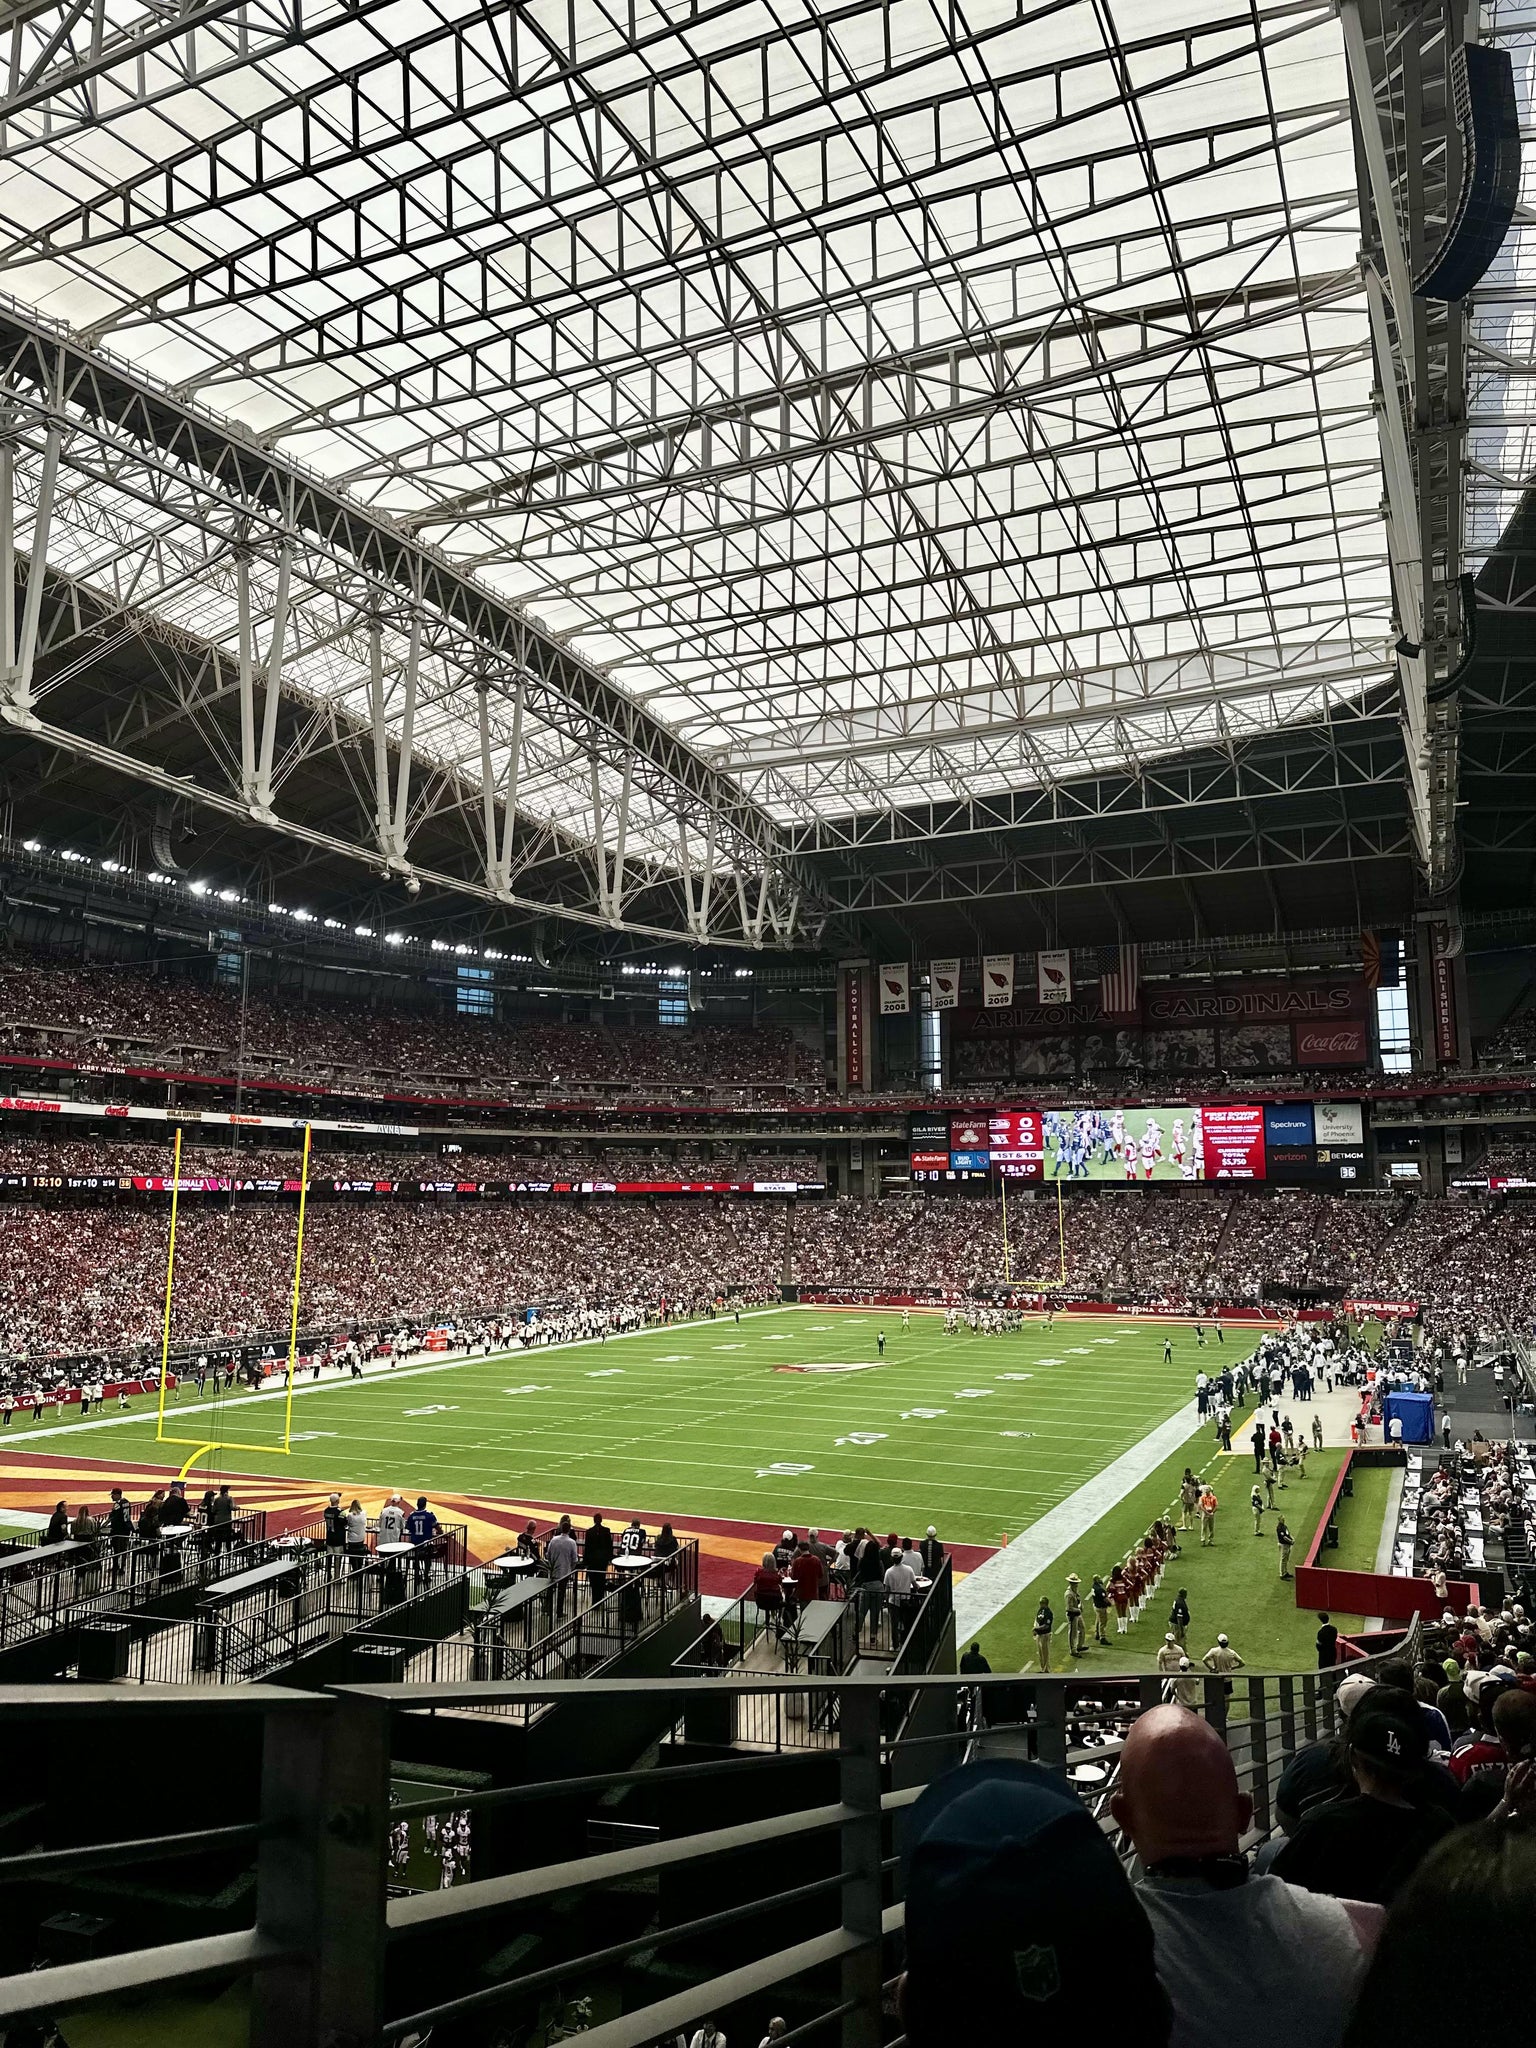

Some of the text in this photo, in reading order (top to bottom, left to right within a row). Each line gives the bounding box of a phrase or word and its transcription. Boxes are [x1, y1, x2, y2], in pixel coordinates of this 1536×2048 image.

[884, 1004, 906, 1012] 2008
[935, 999, 954, 1008] 2008
[1149, 989, 1352, 1020] CARDINALS
[972, 1005, 1113, 1030] ARIZONA
[1300, 1031, 1361, 1053] Coca-Cola
[101, 1066, 126, 1074] WILSON
[1020, 1117, 1033, 1128] 0
[1020, 1132, 1033, 1143] 0
[1273, 1153, 1307, 1161] verizon
[1000, 1164, 1036, 1172] 13:10
[1342, 1168, 1355, 1177] 36
[914, 1171, 939, 1180] 13:10
[33, 1177, 62, 1187] 13:10
[68, 1178, 82, 1188] 1ST
[88, 1178, 98, 1187] 10
[145, 1179, 153, 1189] 0
[833, 1431, 890, 1447] 20
[754, 1462, 816, 1479] 10
[385, 1516, 395, 1530] 12
[414, 1519, 424, 1536] 11
[621, 1533, 640, 1550] 90
[1386, 1730, 1401, 1756] LA
